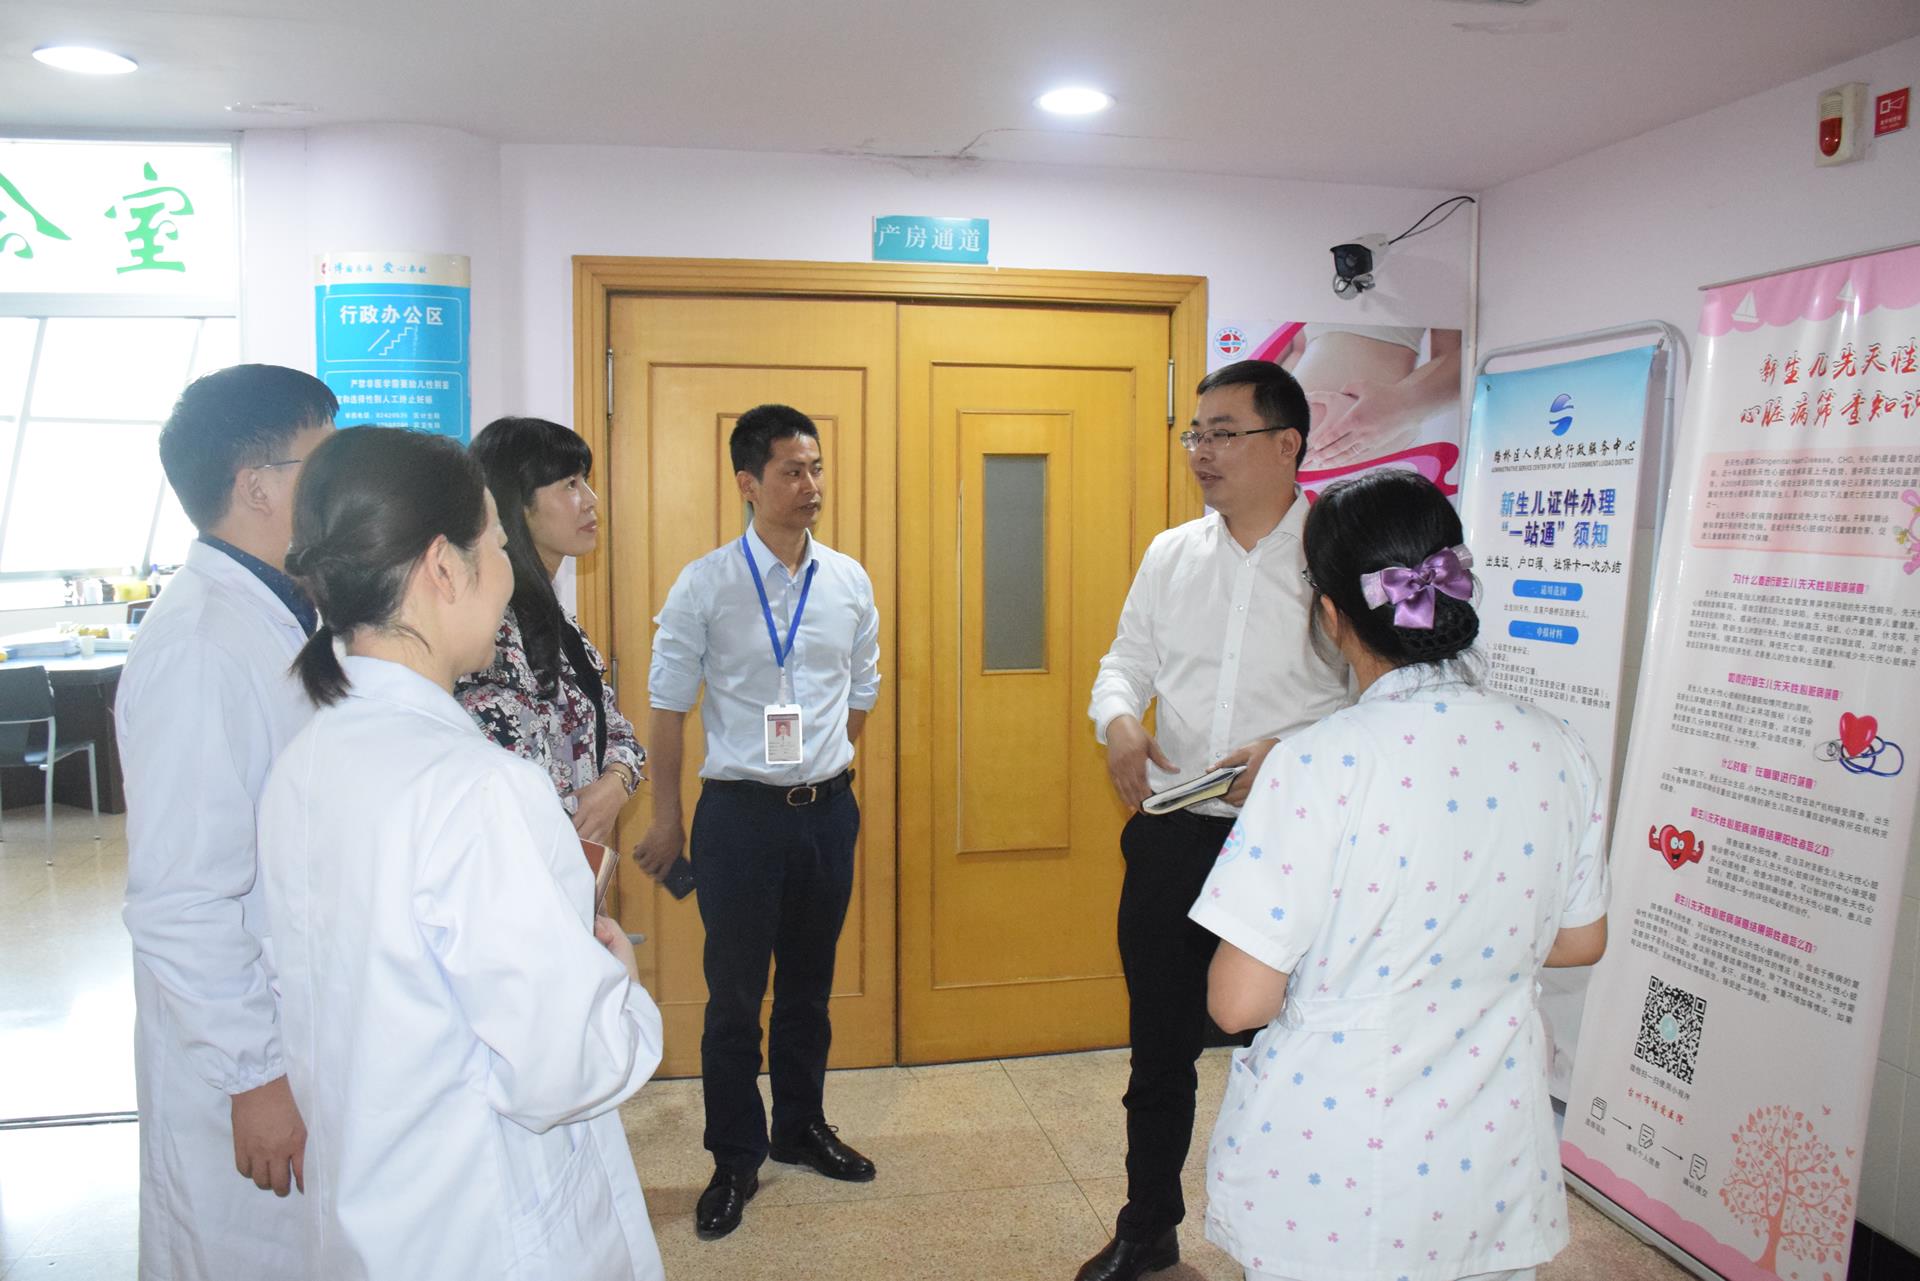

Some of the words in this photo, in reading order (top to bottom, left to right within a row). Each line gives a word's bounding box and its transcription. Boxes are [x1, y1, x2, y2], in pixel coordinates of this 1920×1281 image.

[878, 224, 981, 252] 产房通道
[340, 304, 443, 325] 行政办公区
[1760, 339, 1918, 388] 新生儿先天性
[1493, 440, 1636, 464] 路桥区人民政府行政服务中心
[1500, 488, 1616, 517] 新生儿证件办理
[1573, 521, 1609, 548] 须知
